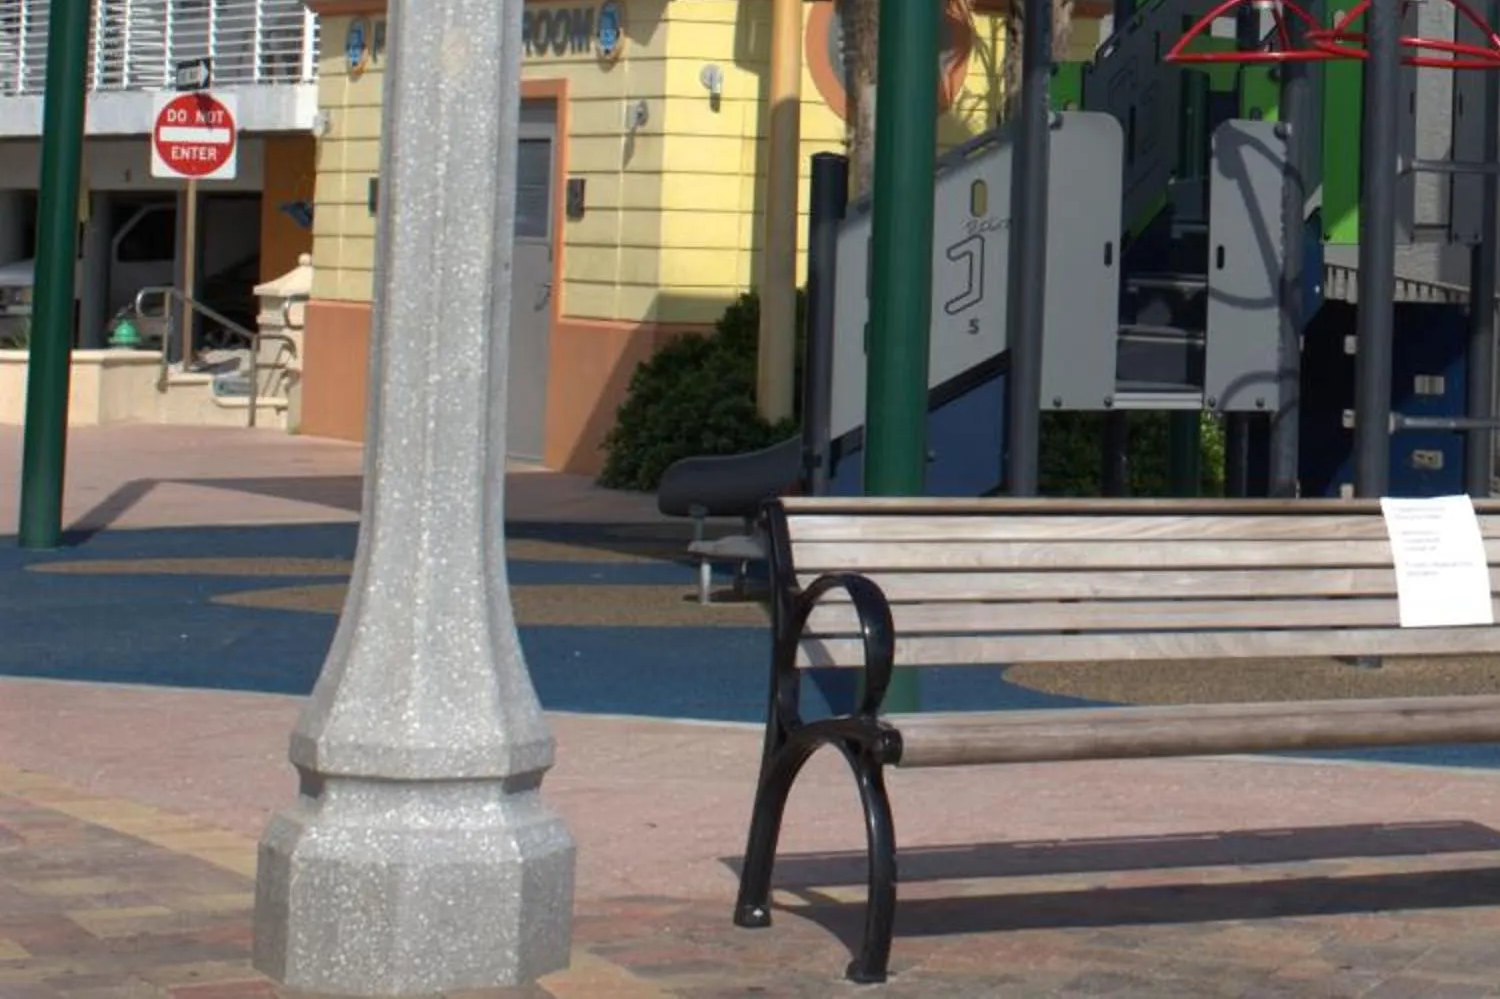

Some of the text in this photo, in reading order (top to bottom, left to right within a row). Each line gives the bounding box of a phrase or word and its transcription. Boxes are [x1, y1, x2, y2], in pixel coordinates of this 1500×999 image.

[167, 109, 224, 124] DO NOT
[171, 146, 217, 161] ENTER
